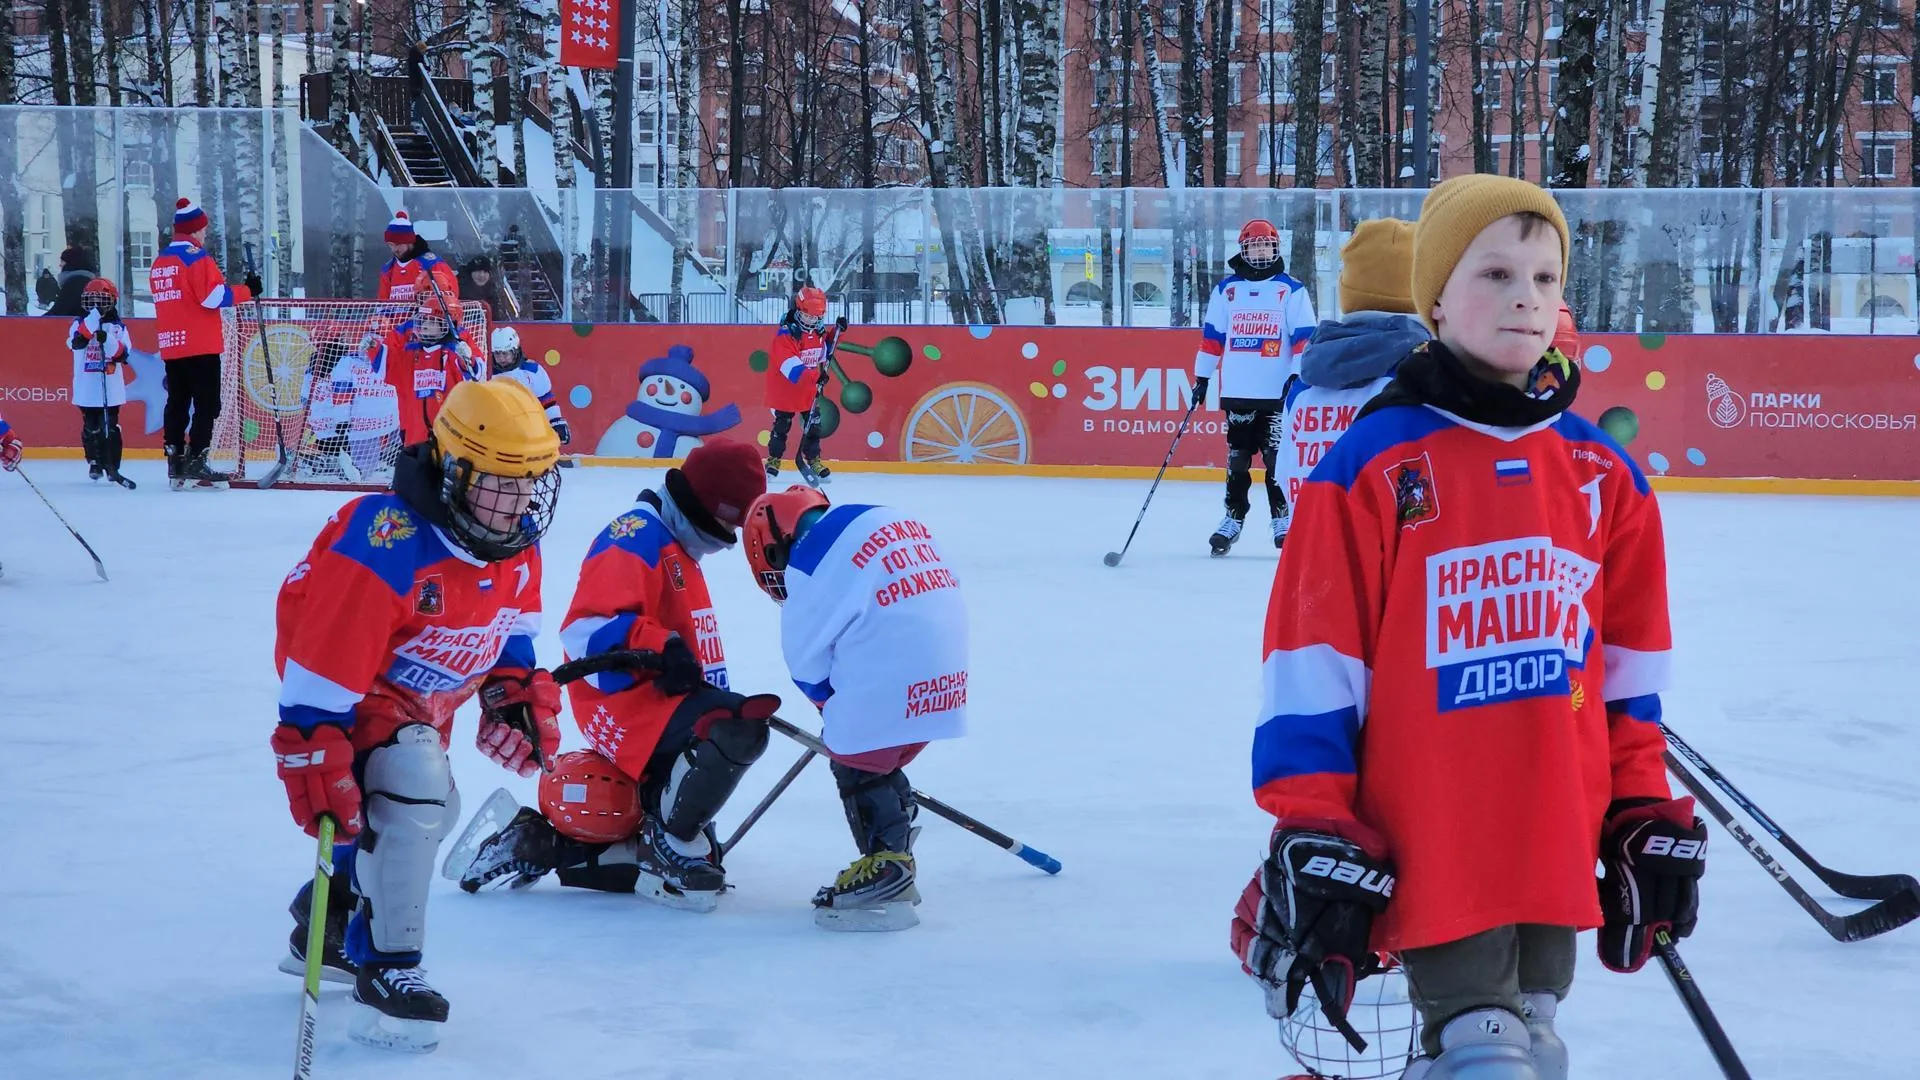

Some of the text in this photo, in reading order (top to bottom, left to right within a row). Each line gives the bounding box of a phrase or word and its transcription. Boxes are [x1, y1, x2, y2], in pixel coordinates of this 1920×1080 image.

[1232, 312, 1270, 322] КРАСНАЯ
[1232, 323, 1278, 336] МАШИНА
[1232, 339, 1259, 349] ДВОР
[0, 387, 68, 402] КОВЬЯ
[1751, 392, 1821, 409] ПАРКИ
[1084, 420, 1095, 433] В
[1750, 412, 1916, 430] ПОДМОСКОВЬЯ
[1573, 448, 1613, 470] Первые
[1454, 653, 1563, 705] ДВОР
[299, 1010, 318, 1077] NORDWAY
